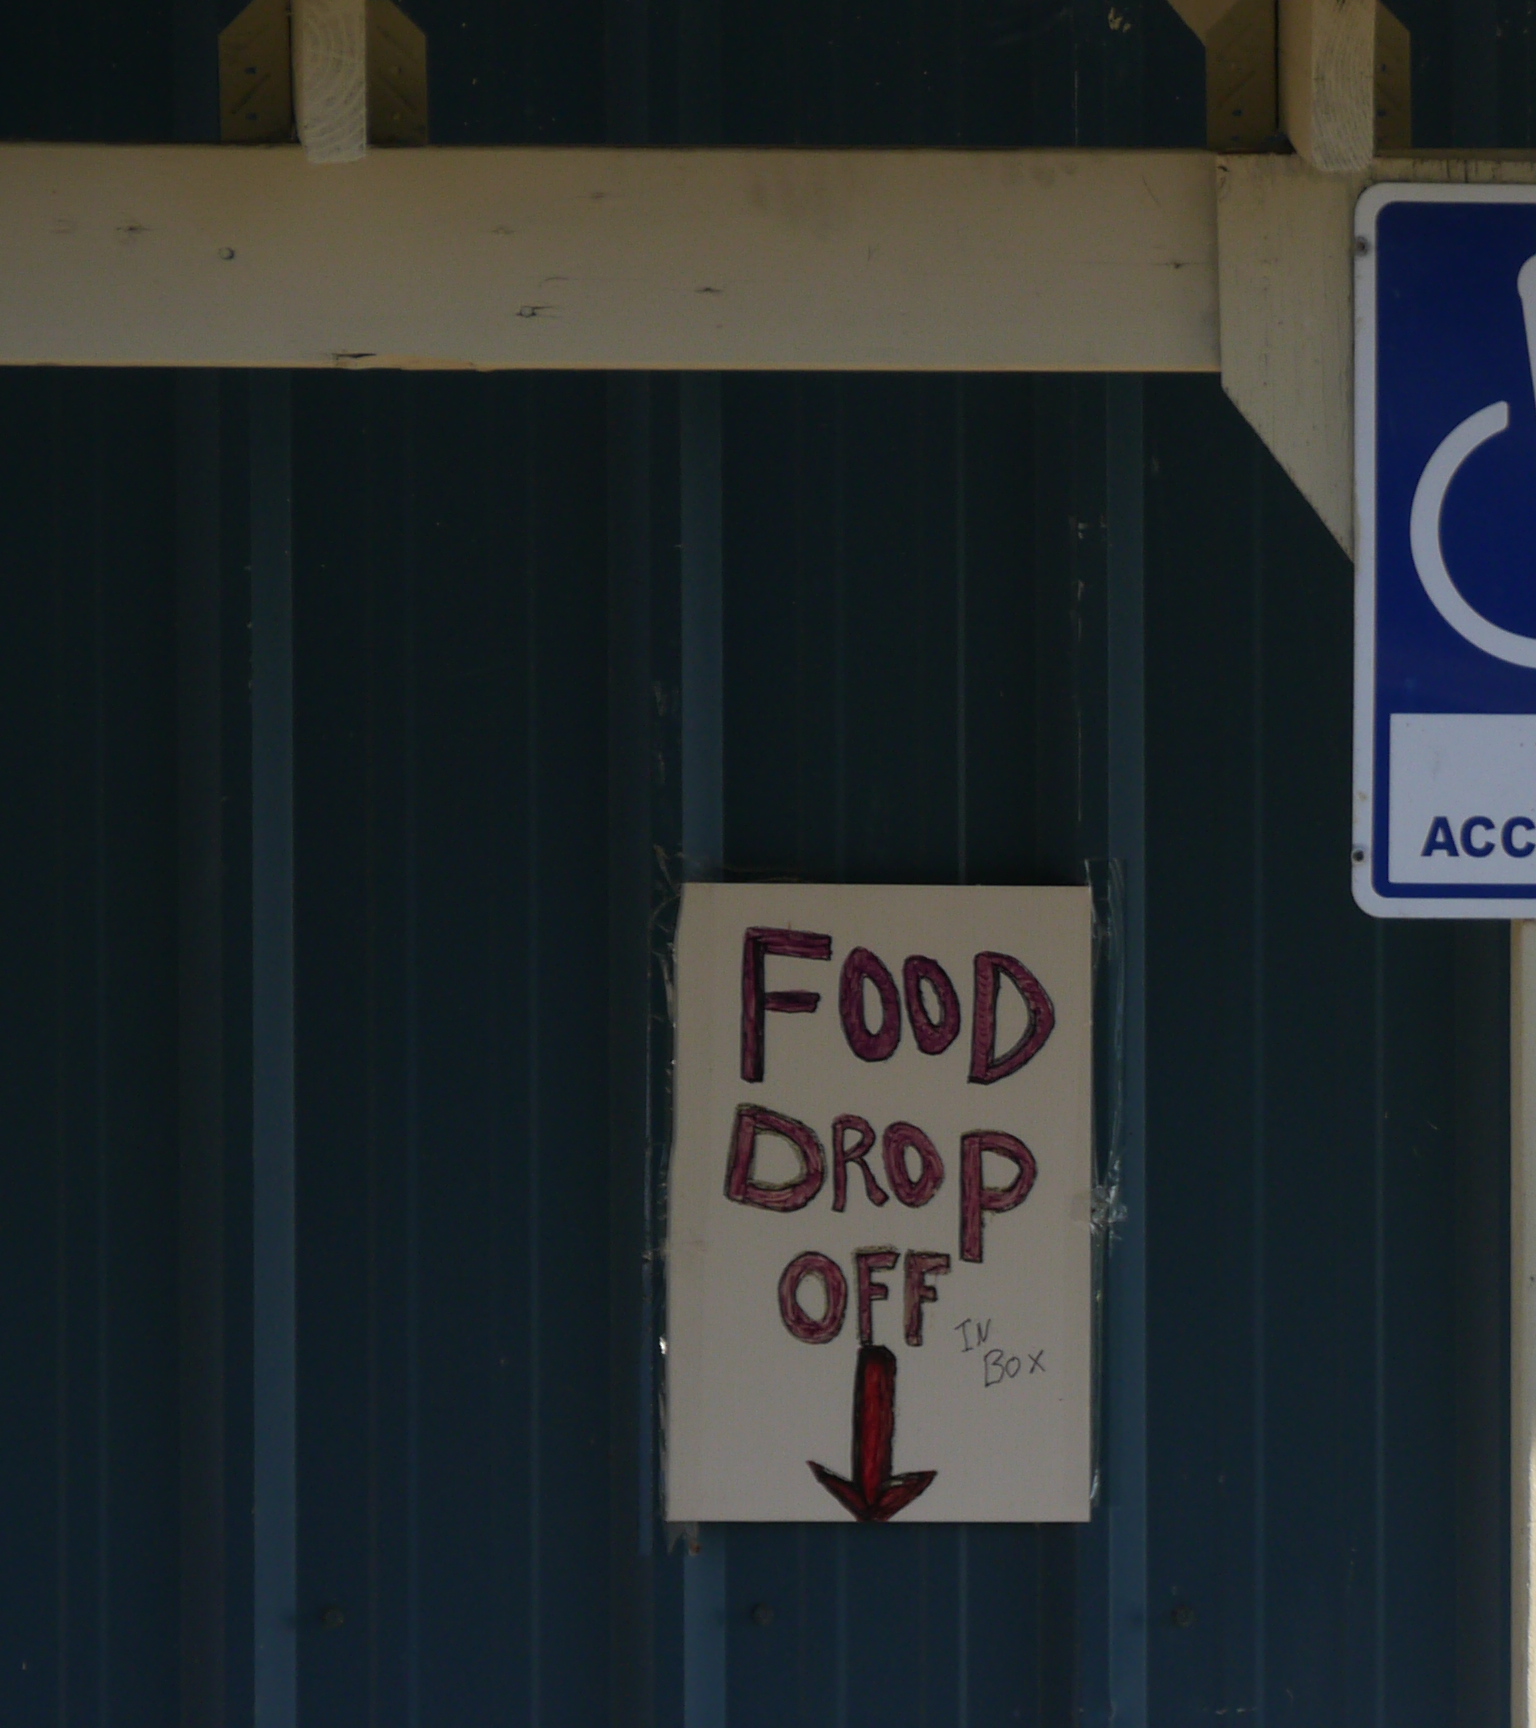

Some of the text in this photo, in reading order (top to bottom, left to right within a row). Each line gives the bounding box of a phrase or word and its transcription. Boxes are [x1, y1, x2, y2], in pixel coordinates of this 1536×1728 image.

[740, 926, 1055, 1085] FOOD
[724, 1103, 1037, 1263] DROP
[777, 1244, 951, 1347] OFF
[954, 1317, 992, 1353] IN
